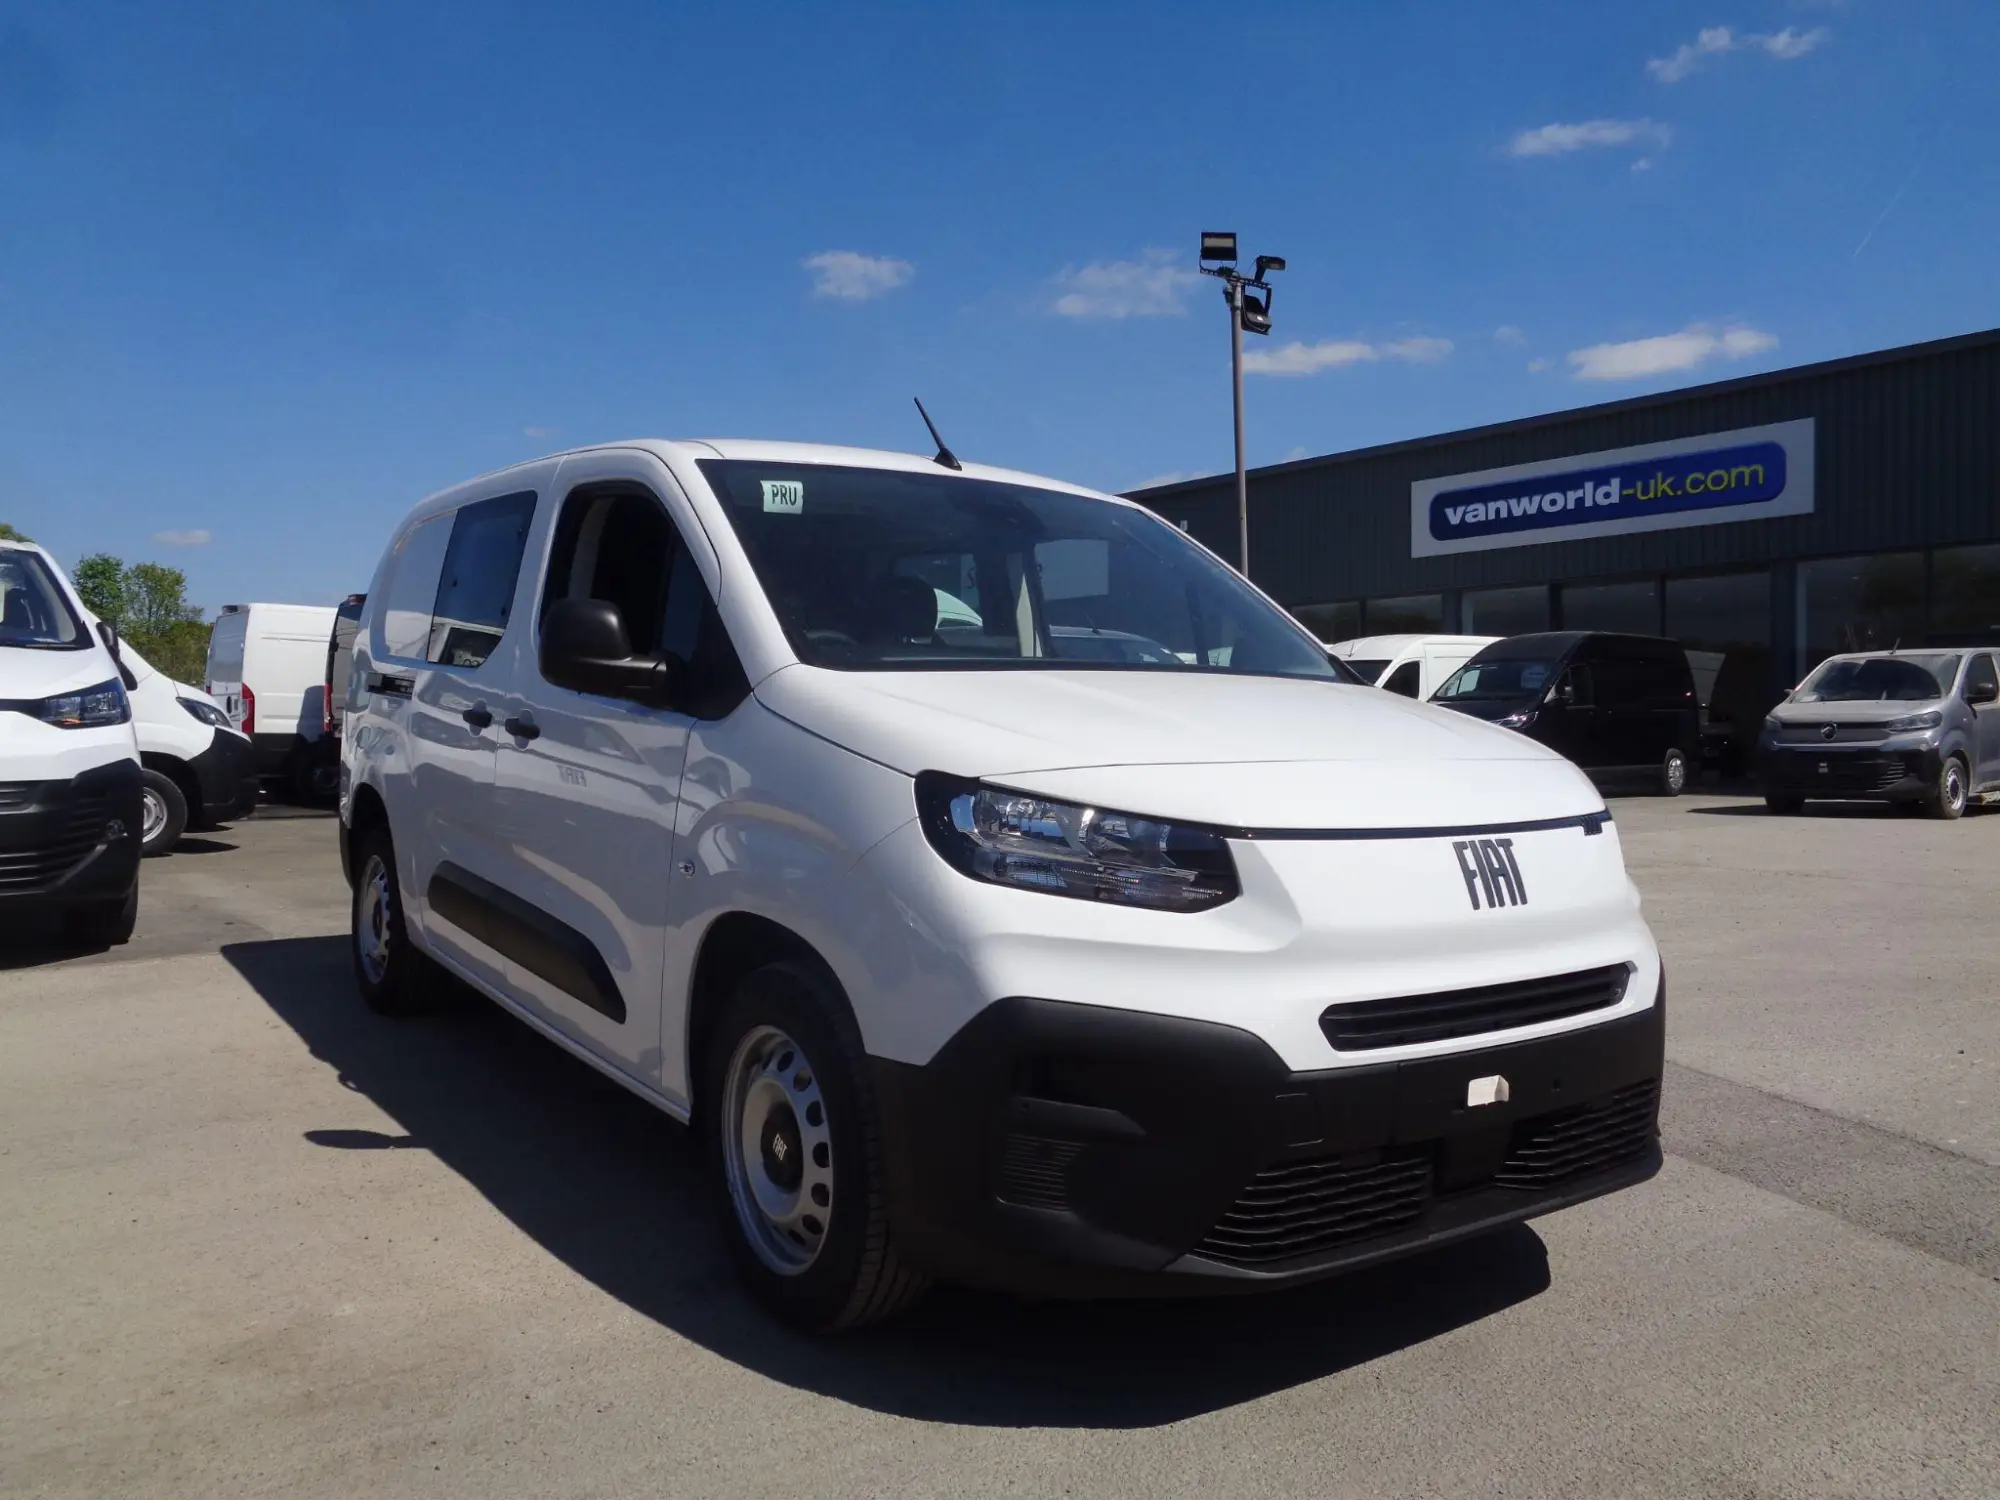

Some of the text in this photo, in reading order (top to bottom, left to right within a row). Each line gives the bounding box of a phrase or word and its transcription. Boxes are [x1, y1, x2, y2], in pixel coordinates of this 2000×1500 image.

[771, 484, 797, 506] PRU
[1444, 463, 1764, 525] vanworld-uk.com
[1452, 838, 1528, 911] FIAT
